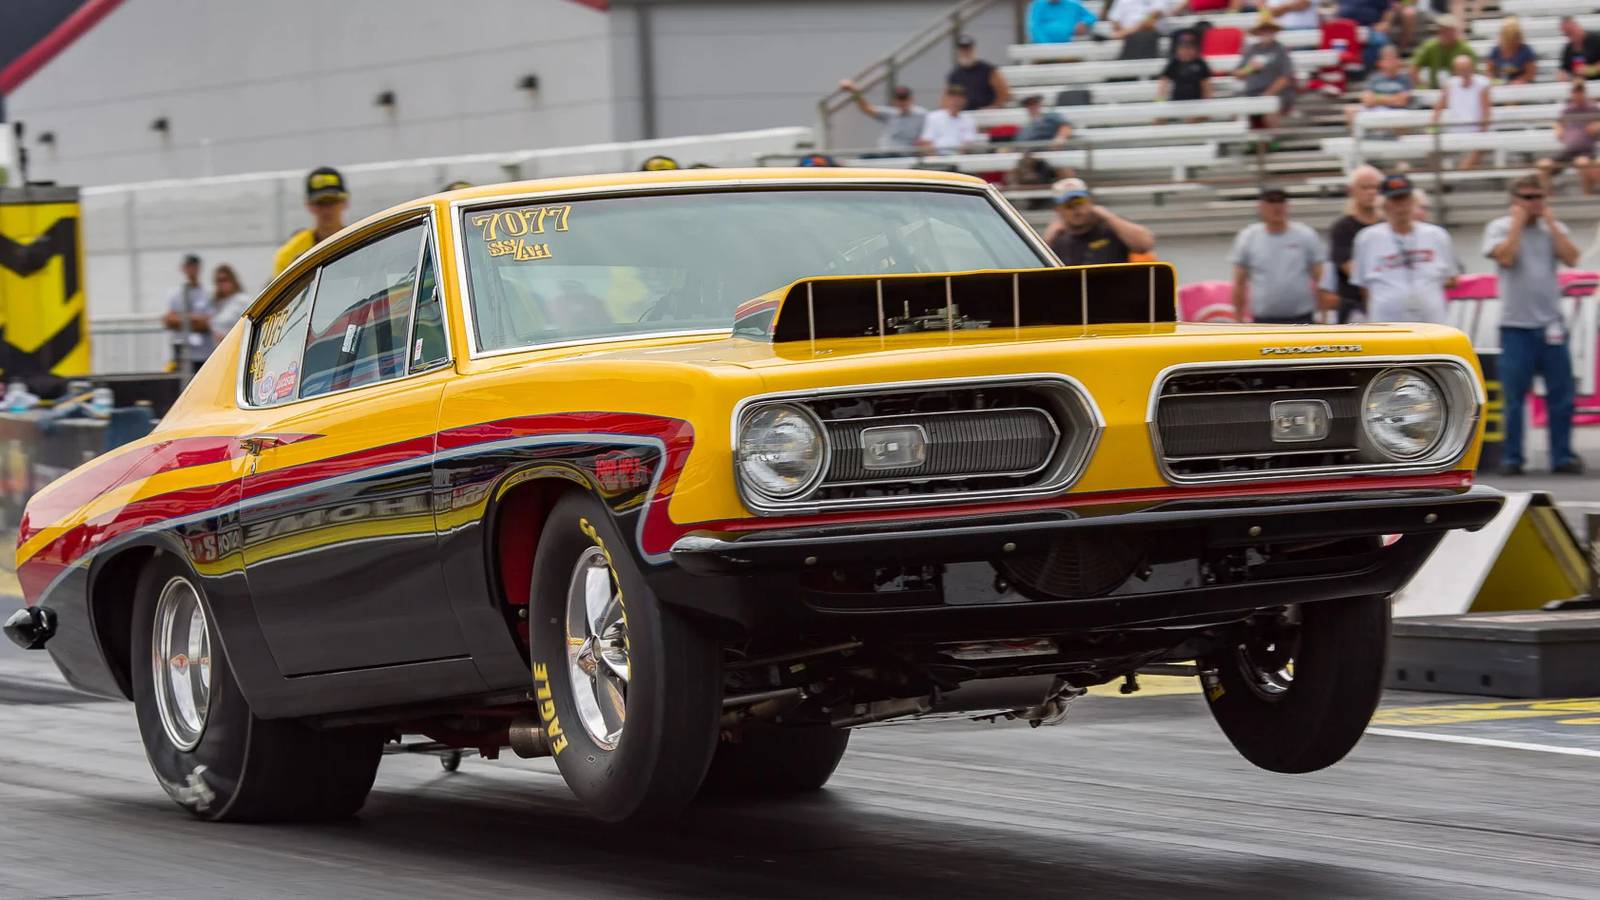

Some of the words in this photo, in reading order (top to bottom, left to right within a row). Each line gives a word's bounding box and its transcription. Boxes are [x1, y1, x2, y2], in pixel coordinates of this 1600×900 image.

[472, 205, 571, 242] 7077
[487, 239, 552, 262] SS/AH
[1260, 344, 1362, 355] PLYMOUTH
[533, 661, 569, 755] EAGLE
